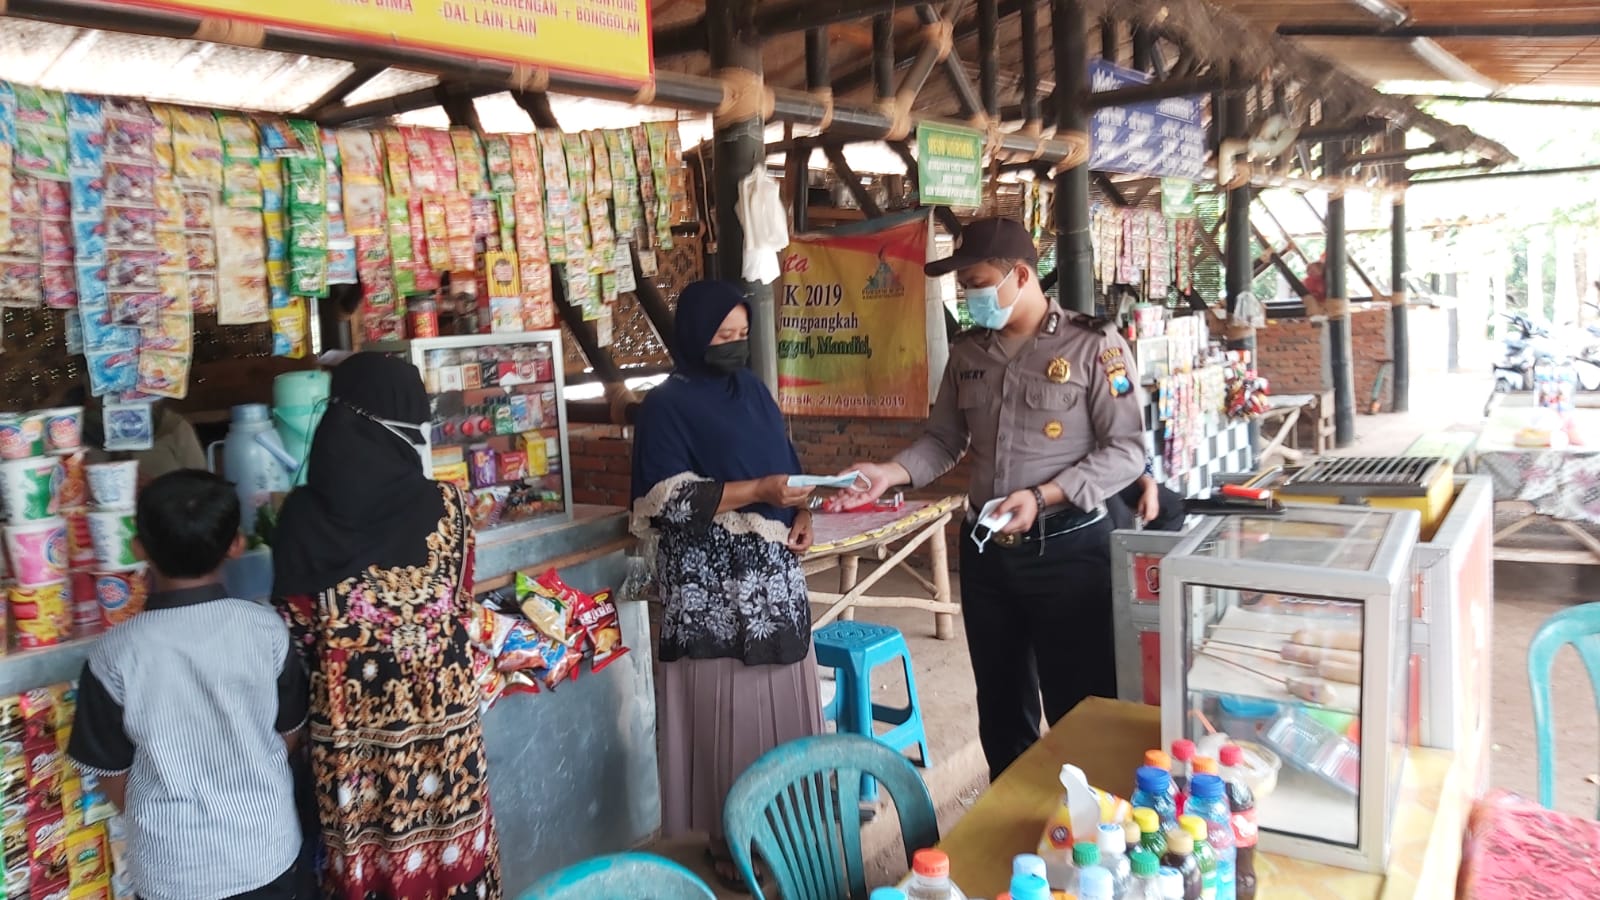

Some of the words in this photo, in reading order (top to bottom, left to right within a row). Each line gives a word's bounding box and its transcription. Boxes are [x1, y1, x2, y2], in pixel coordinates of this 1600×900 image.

[474, 7, 537, 34] LAIN-LAIN
[780, 284, 800, 306] K
[805, 284, 842, 306] 2019
[879, 394, 905, 408] 2019
